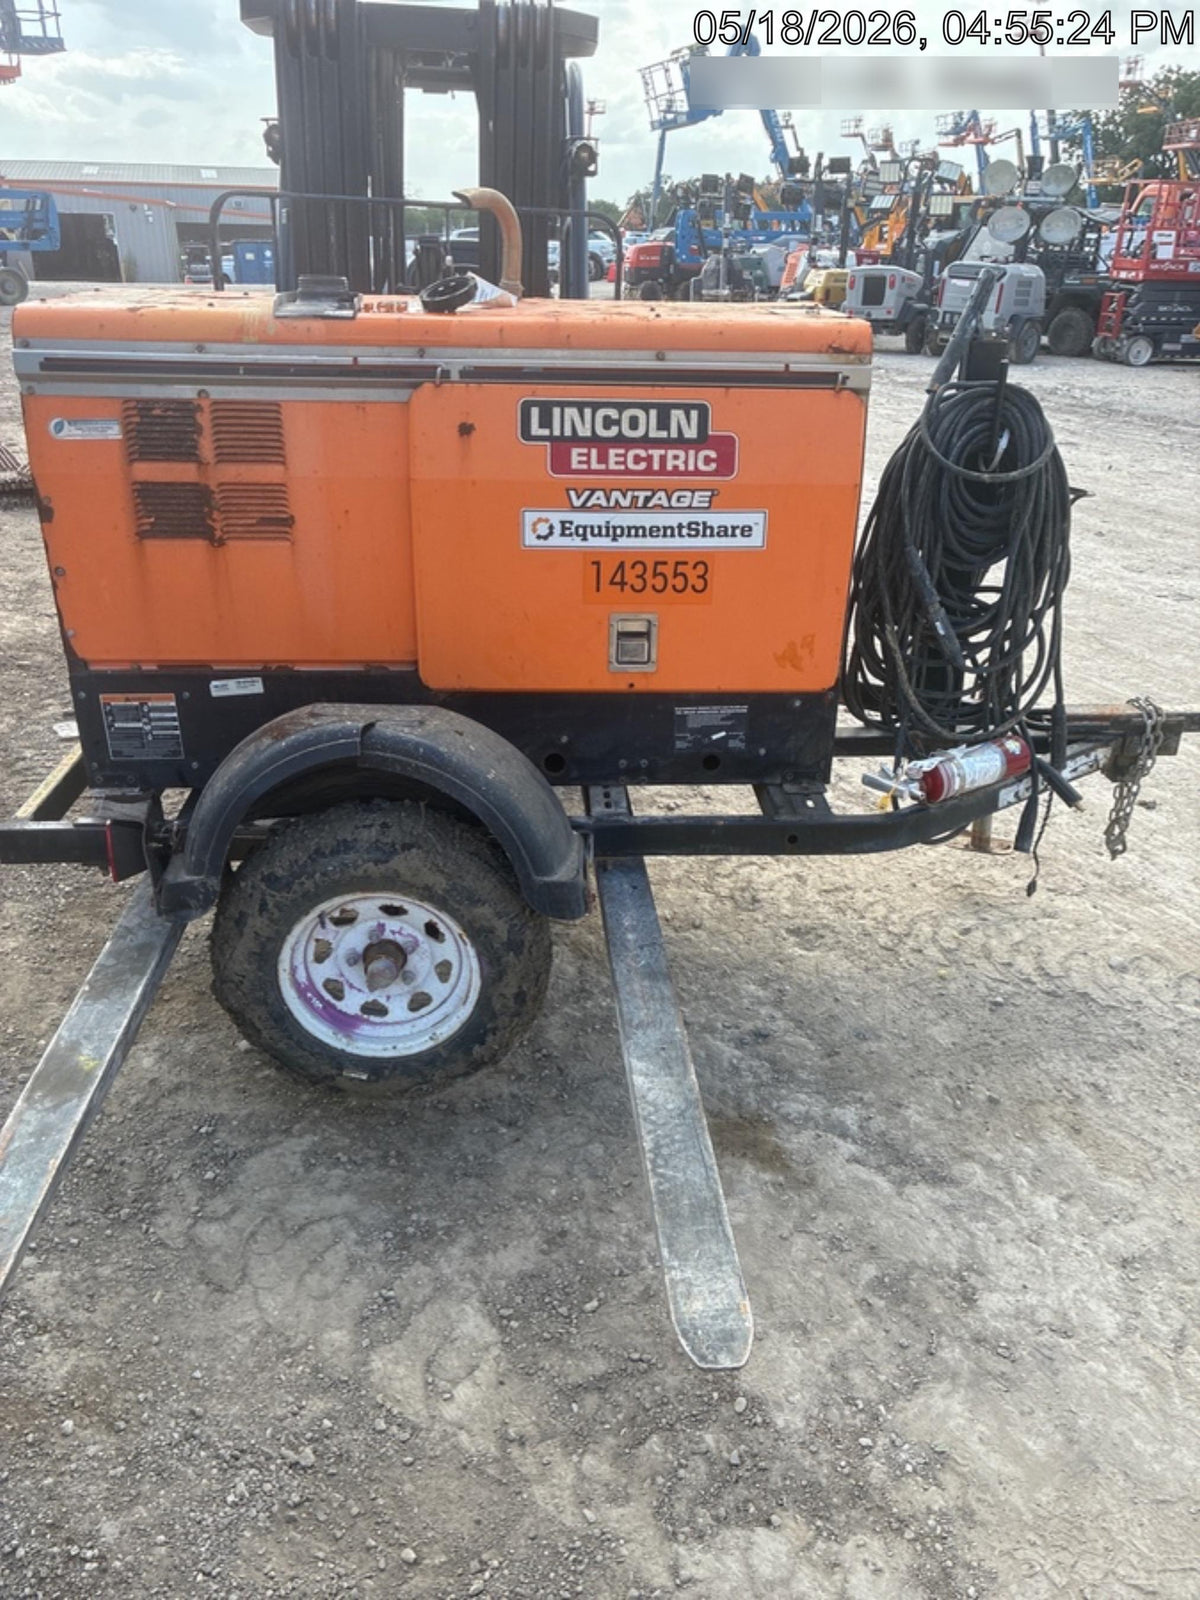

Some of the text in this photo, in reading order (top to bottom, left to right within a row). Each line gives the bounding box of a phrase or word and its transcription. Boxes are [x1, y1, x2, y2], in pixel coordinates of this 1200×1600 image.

[530, 406, 699, 439] LINCOLN
[570, 447, 718, 472] ELECTRIC
[566, 488, 713, 509] VANTAGE
[559, 520, 754, 542] EquipmentShare
[590, 560, 709, 594] 143553
